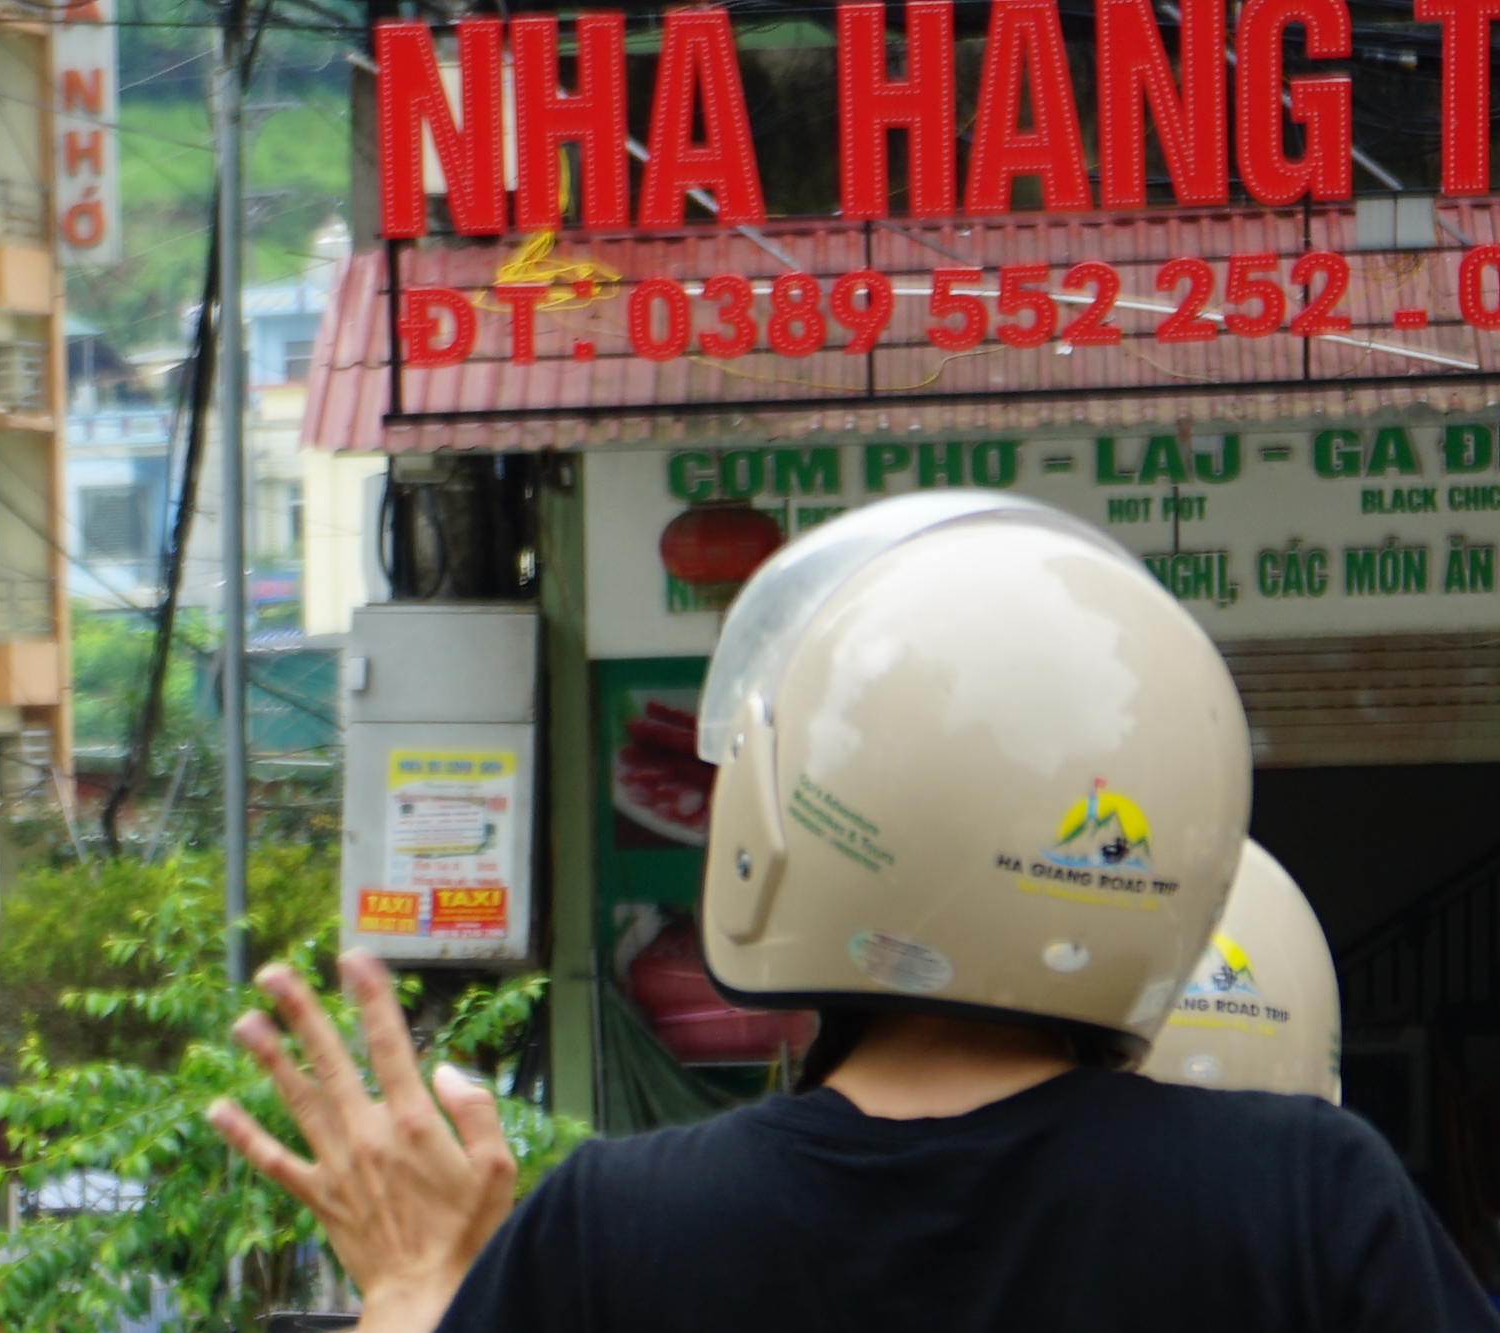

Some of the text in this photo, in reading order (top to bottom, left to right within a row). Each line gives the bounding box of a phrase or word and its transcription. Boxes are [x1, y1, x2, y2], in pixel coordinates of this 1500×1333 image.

[627, 270, 895, 362] 0389
[927, 260, 1122, 351] 552
[1155, 250, 1352, 342] 252
[1107, 496, 1207, 523] HOT POT
[1360, 487, 1438, 514] BLACK
[1258, 539, 1329, 597] CÁC
[1345, 536, 1426, 595] MÓN
[1445, 534, 1494, 593] ĂN
[996, 854, 1023, 873] HA
[1031, 863, 1093, 887] GIANG
[1099, 874, 1147, 893] ROAD
[1153, 880, 1181, 897] TRIP
[368, 895, 414, 914] TAXI
[437, 891, 501, 908] TAXI
[1215, 999, 1260, 1017] ROAD
